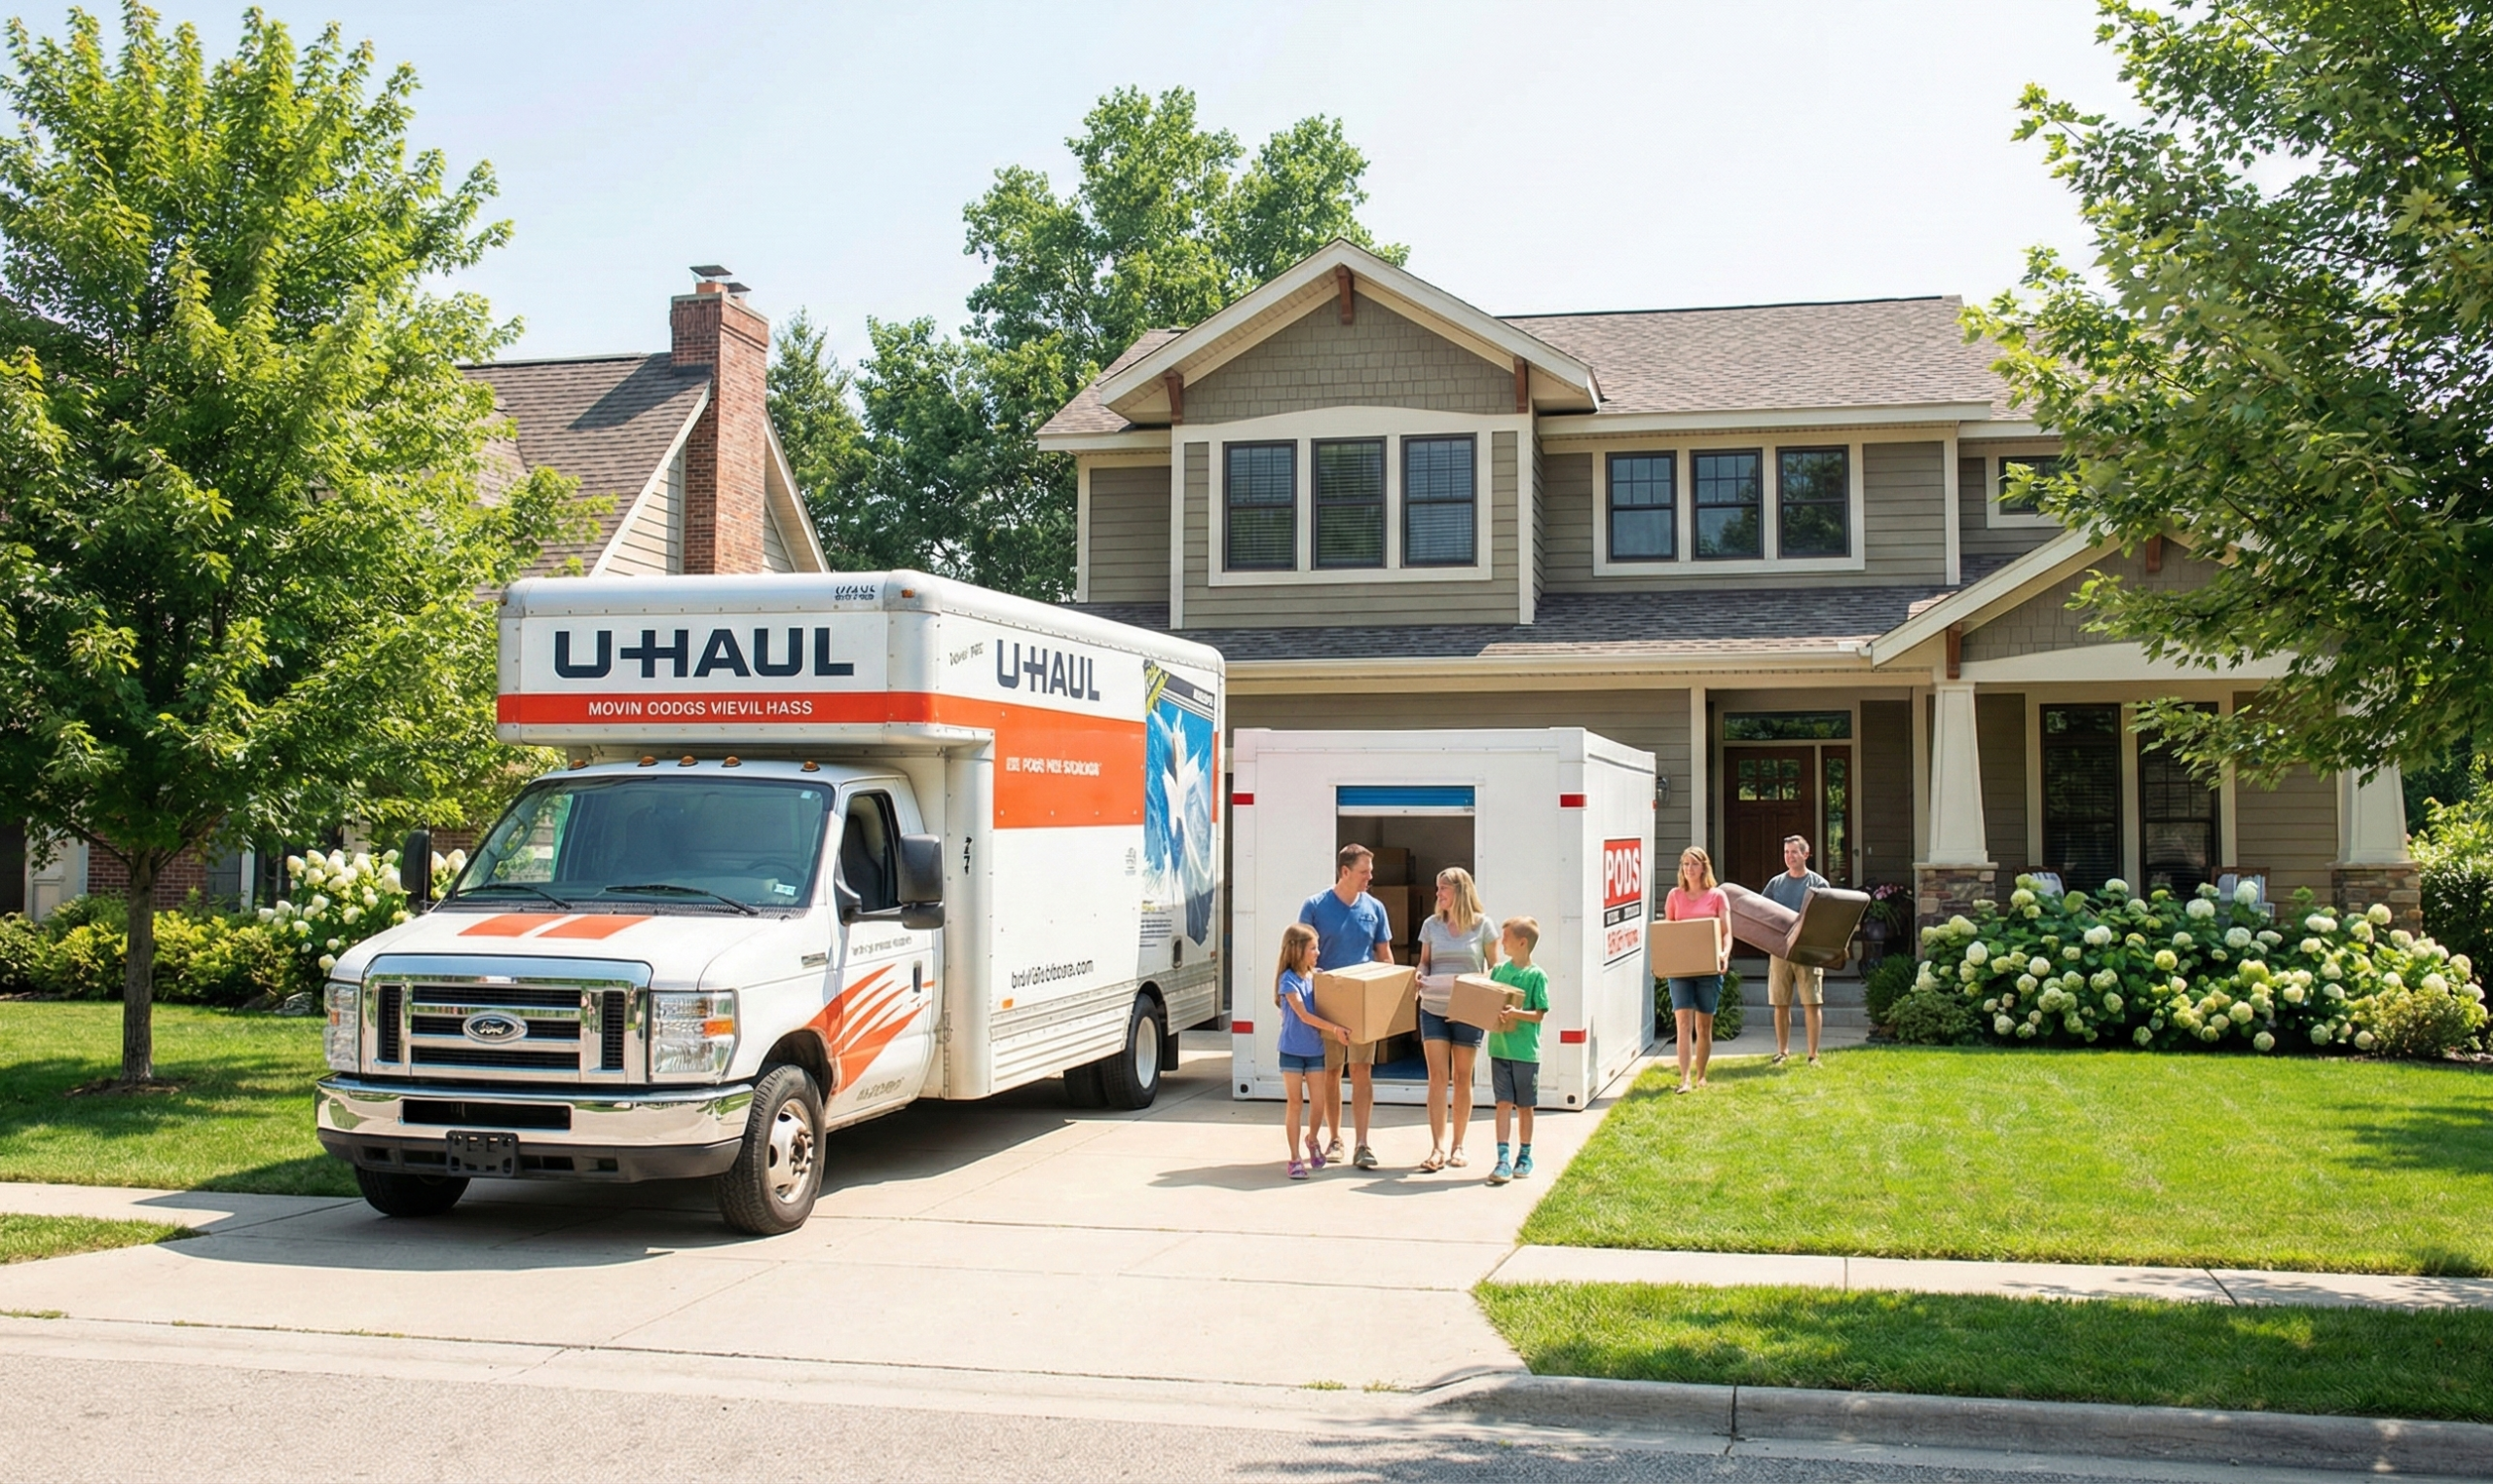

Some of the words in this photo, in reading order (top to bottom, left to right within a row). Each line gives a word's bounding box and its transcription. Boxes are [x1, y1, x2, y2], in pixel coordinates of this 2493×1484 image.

[554, 627, 854, 679] U-HAUL
[996, 639, 1100, 702] U-HAUL
[588, 701, 642, 716] MOVIN
[766, 700, 813, 715] HASS
[1605, 846, 1641, 900] PODS
